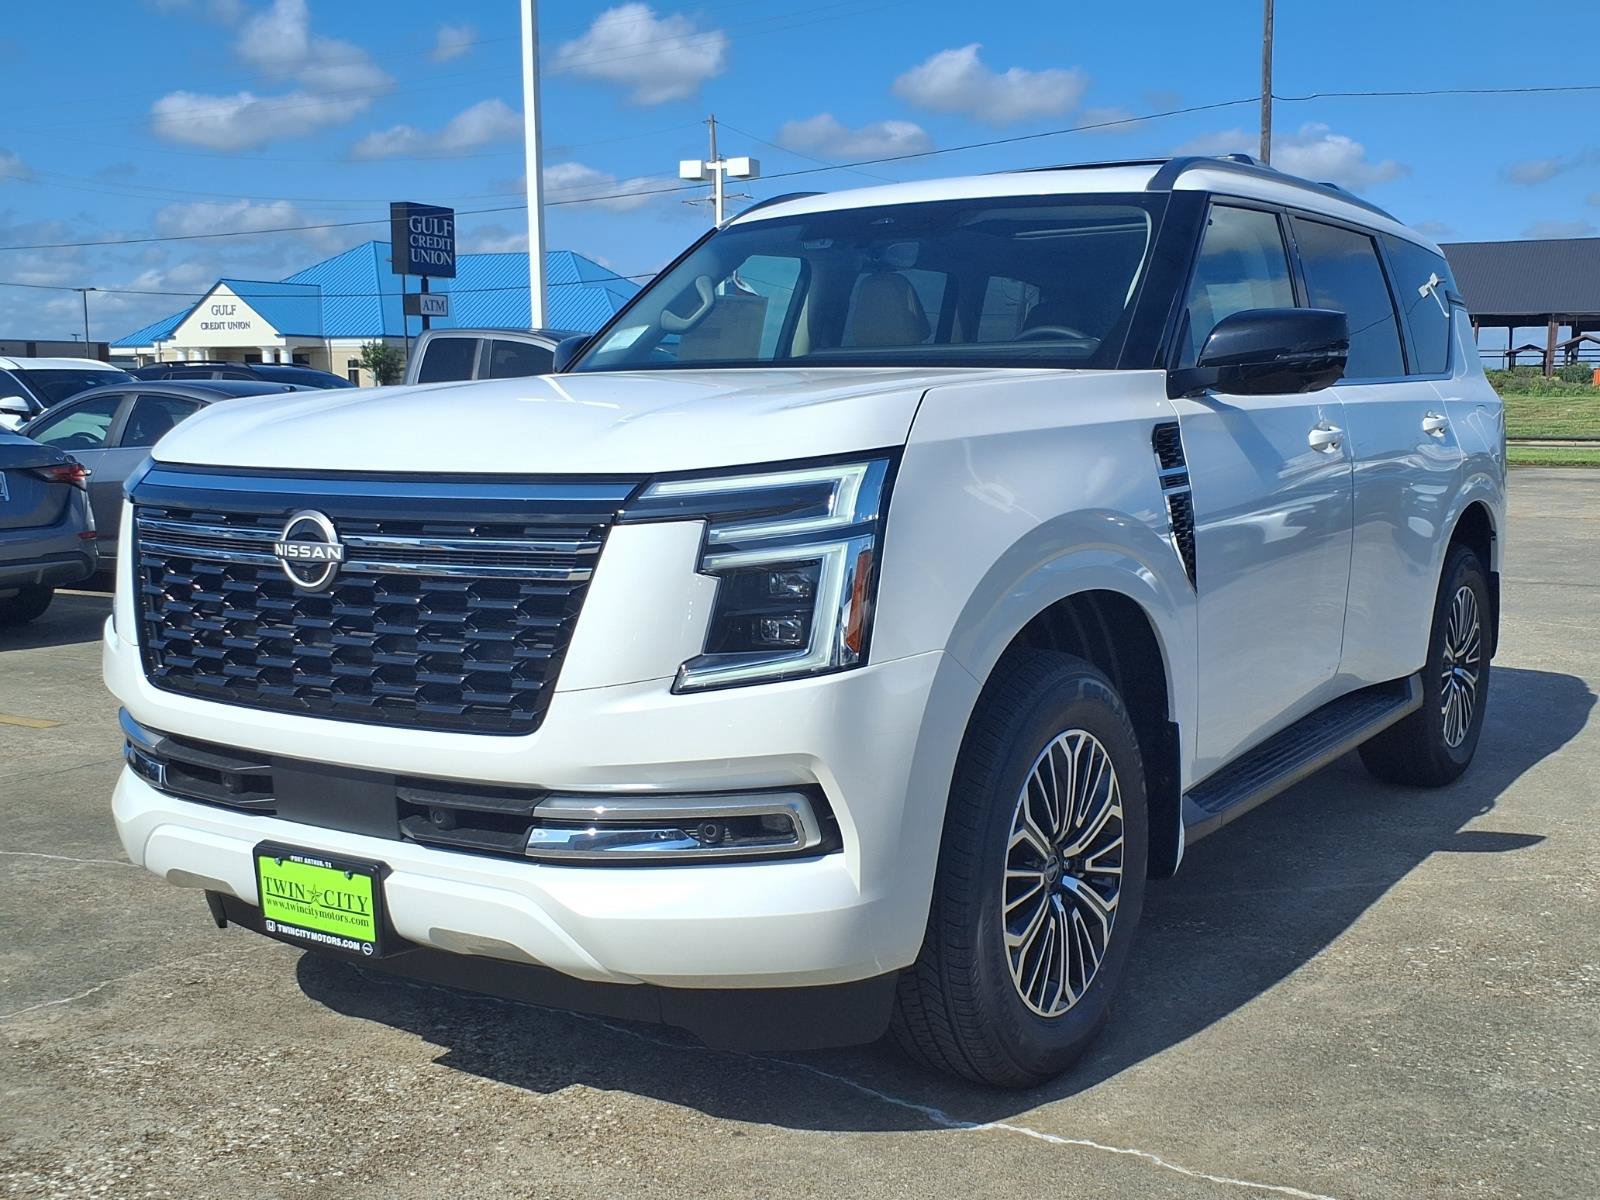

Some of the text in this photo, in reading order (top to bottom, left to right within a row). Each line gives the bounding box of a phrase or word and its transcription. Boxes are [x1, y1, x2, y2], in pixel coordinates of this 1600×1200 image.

[409, 215, 453, 236] GULF
[409, 234, 453, 250] CREDIT
[410, 248, 453, 265] UNION
[211, 304, 237, 316] GULF
[422, 299, 445, 312] ATM
[200, 320, 251, 330] CREDIT UNION
[274, 543, 342, 560] NISSAN
[263, 876, 368, 912] TWIN CITY
[266, 897, 370, 927] www.twincitymotors.com
[277, 923, 361, 951] TWINCITYMOTORS.COM
